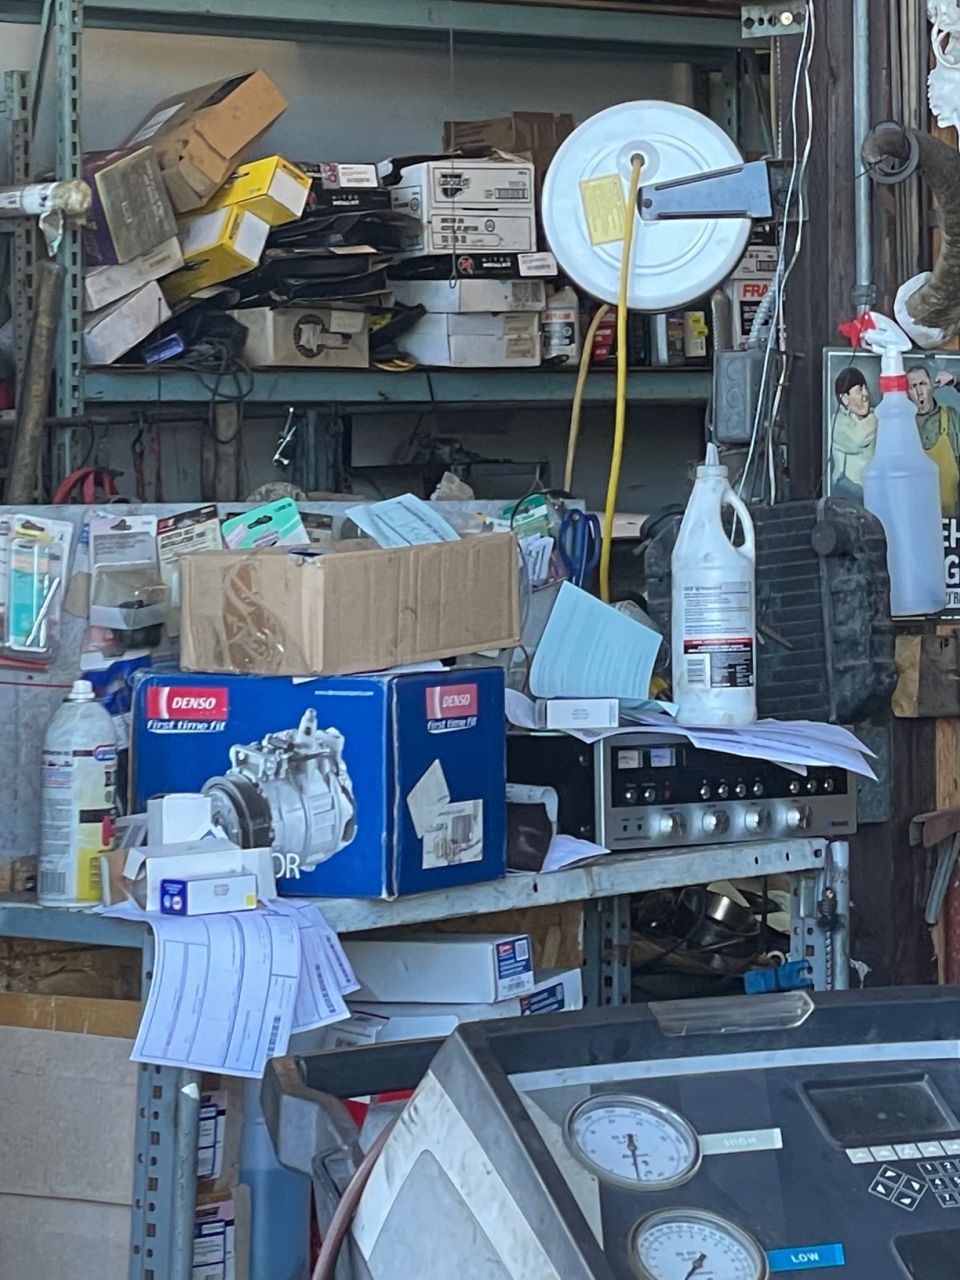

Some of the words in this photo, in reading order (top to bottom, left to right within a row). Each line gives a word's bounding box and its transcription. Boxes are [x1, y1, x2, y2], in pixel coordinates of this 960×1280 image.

[742, 283, 769, 297] FRA
[172, 697, 216, 709] DENSO
[443, 693, 470, 708] DENSO
[147, 720, 174, 731] first
[176, 720, 208, 731] time
[210, 720, 226, 731] fit
[272, 853, 300, 879] OR
[791, 1252, 819, 1263] LOW
